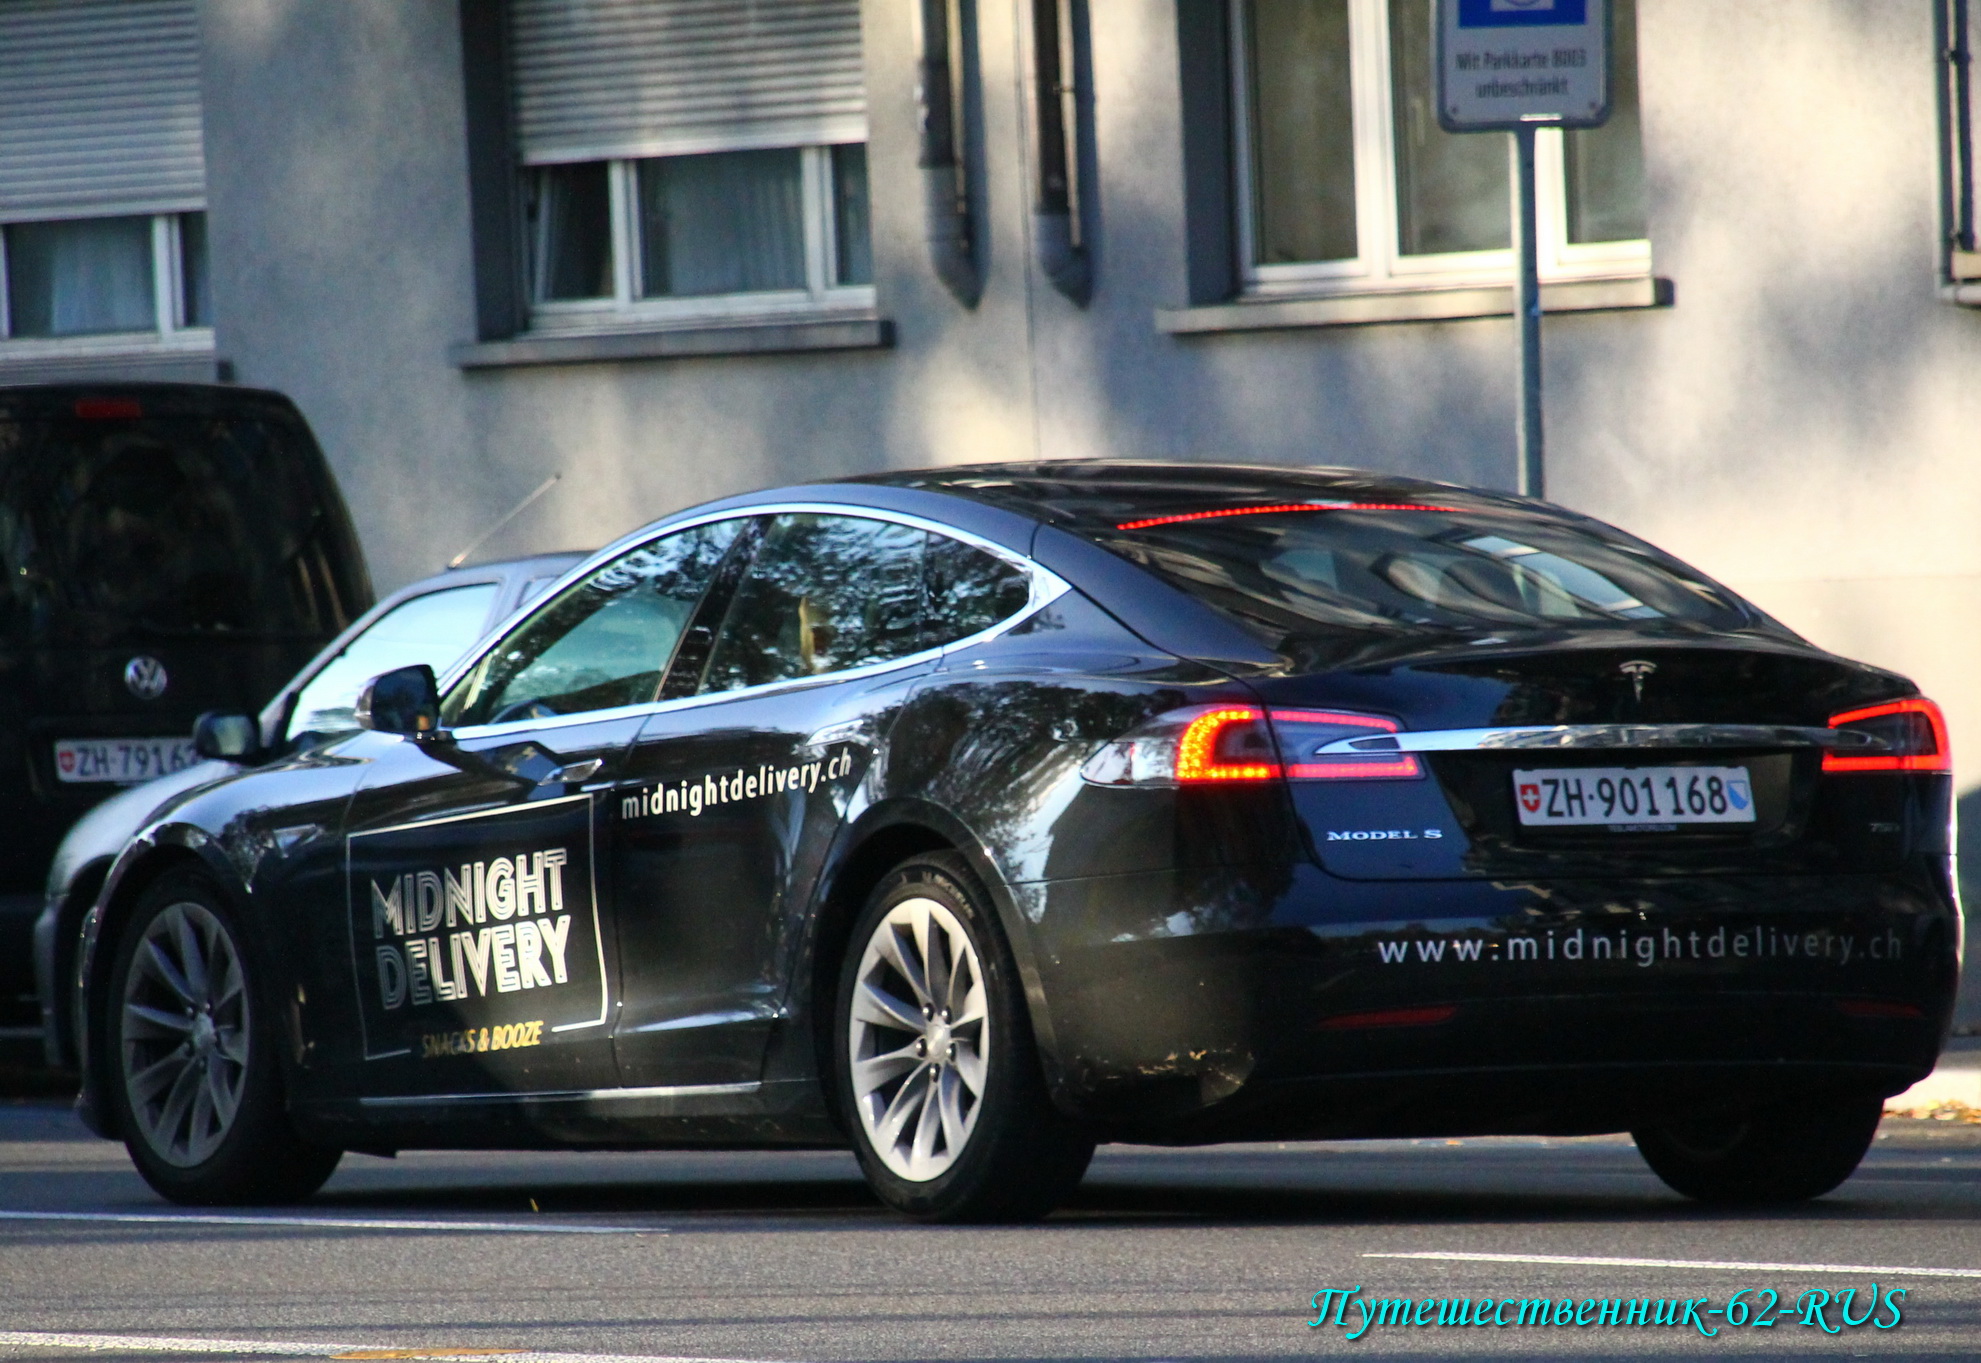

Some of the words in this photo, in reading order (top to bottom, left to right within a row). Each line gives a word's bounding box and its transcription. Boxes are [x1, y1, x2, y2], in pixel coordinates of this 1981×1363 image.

[622, 747, 852, 820] midnightdelivery.ch
[1326, 829, 1419, 841] MODEL
[1423, 828, 1443, 840] S
[371, 848, 568, 939] MIDNIGHT
[375, 915, 572, 1010] DELIVERY
[1377, 926, 1901, 967] www.midnightdelivery.ch
[477, 1026, 490, 1053] &
[491, 1020, 545, 1051] BOOZE
